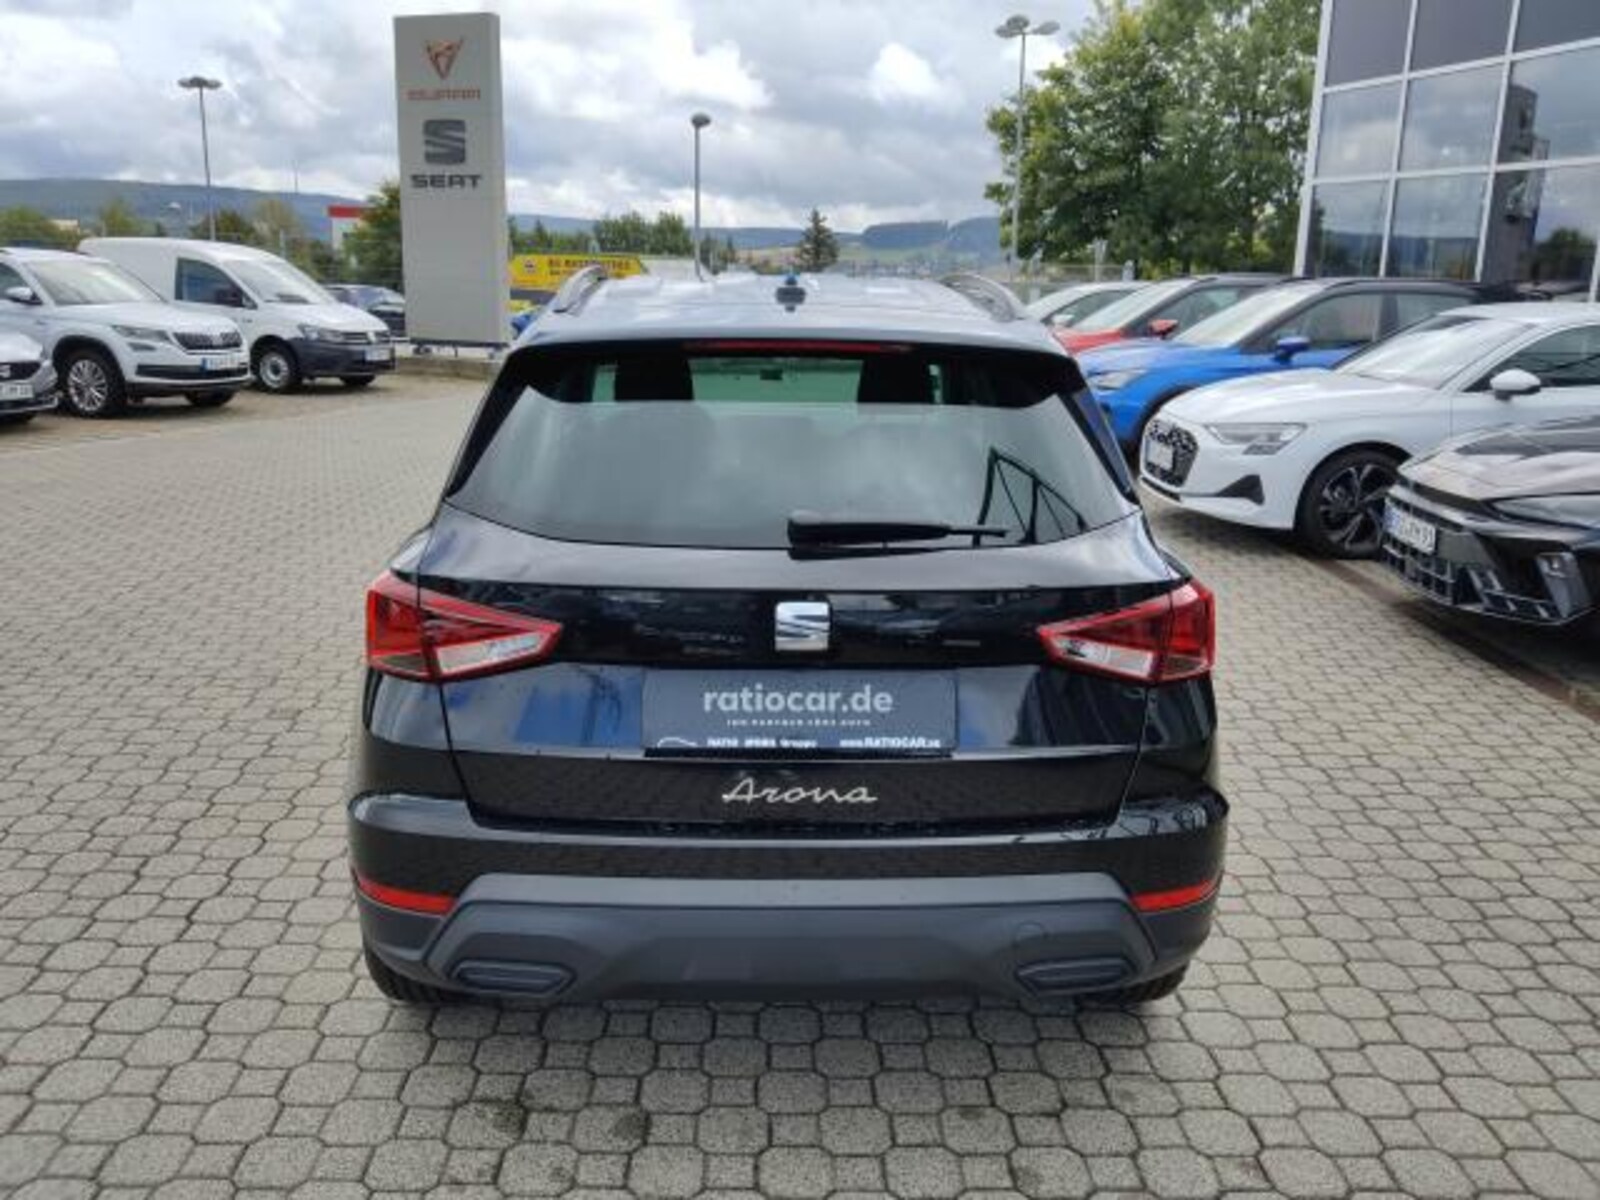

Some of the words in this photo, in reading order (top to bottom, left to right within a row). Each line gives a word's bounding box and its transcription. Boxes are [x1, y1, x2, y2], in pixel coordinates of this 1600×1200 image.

[410, 174, 482, 189] SEAT
[703, 683, 894, 713] ratiocar.de
[722, 776, 878, 804] Arona
